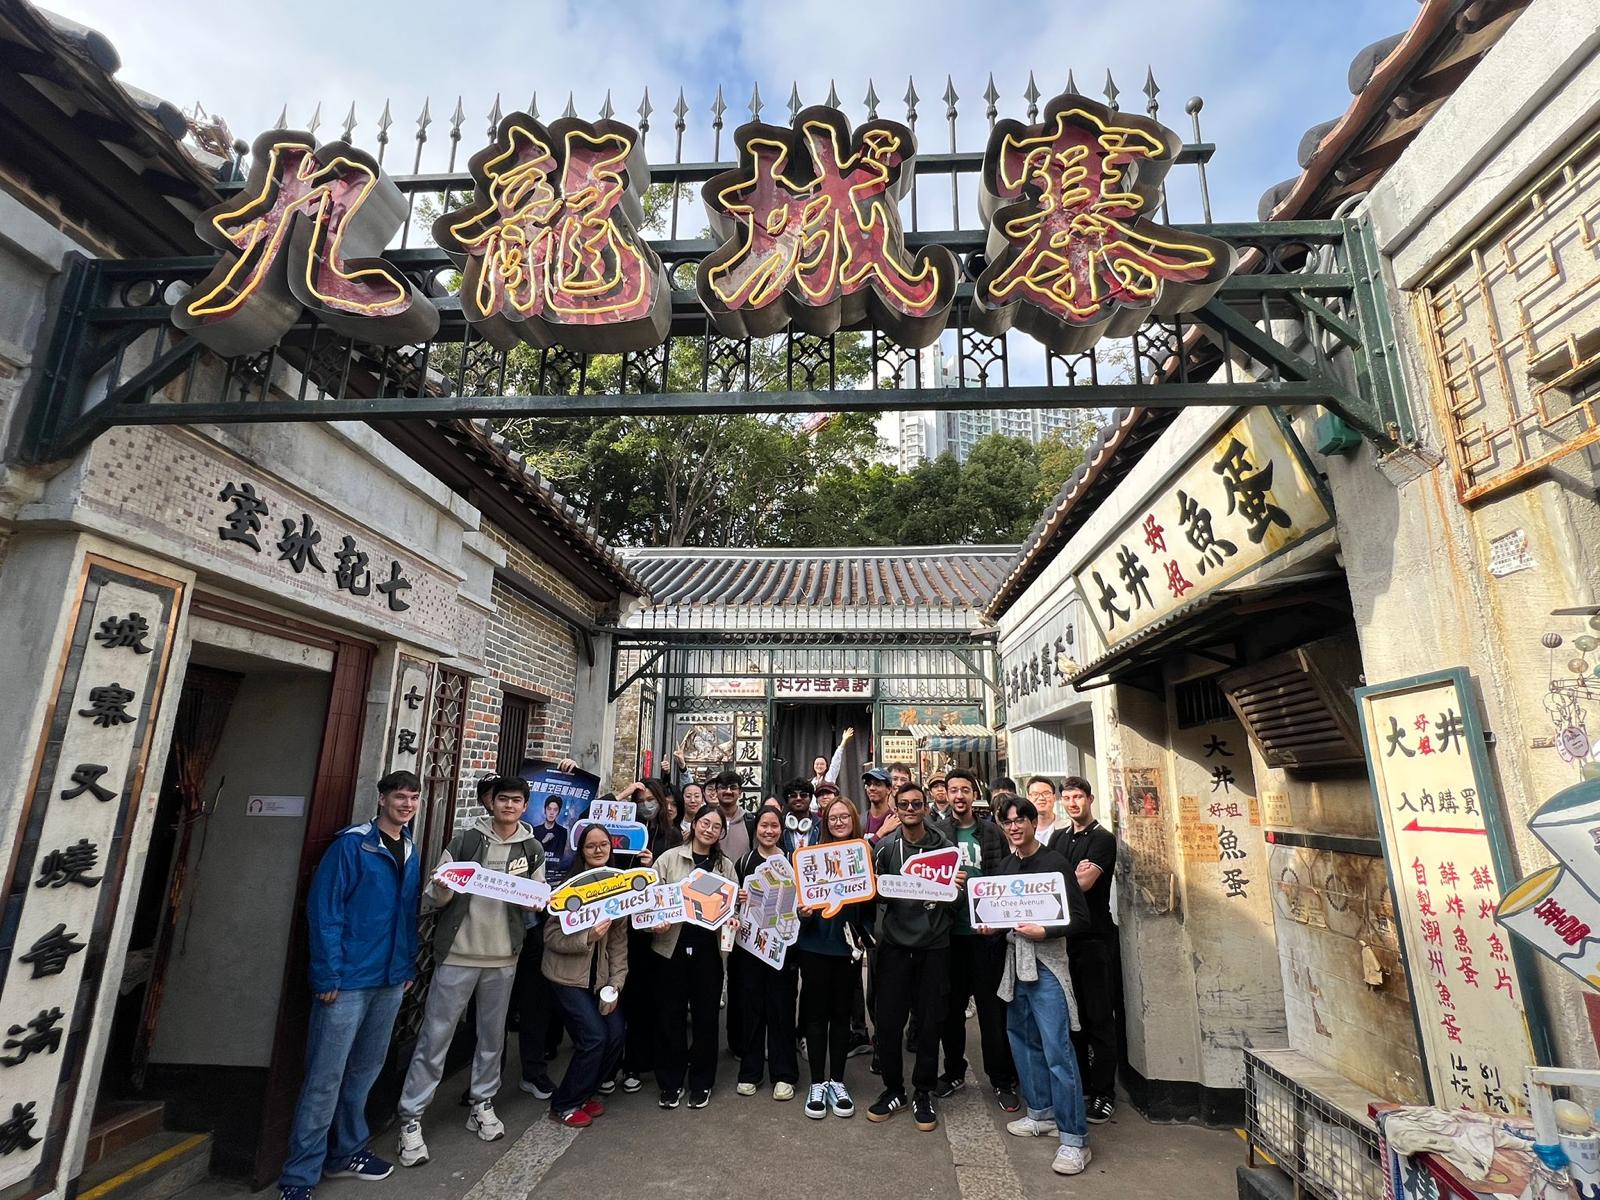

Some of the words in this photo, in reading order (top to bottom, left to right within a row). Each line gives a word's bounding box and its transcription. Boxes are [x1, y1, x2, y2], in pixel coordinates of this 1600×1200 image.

[180, 100, 1225, 328] 九龍城寨
[1397, 788, 1480, 816] 入內購買
[444, 871, 470, 885] CityU
[910, 863, 953, 882] CityU
[807, 887, 831, 900] City
[834, 879, 866, 897] Quest
[974, 881, 1007, 899] City
[1010, 878, 1057, 897] Quest
[566, 904, 601, 926] City
[605, 888, 650, 916] Quest
